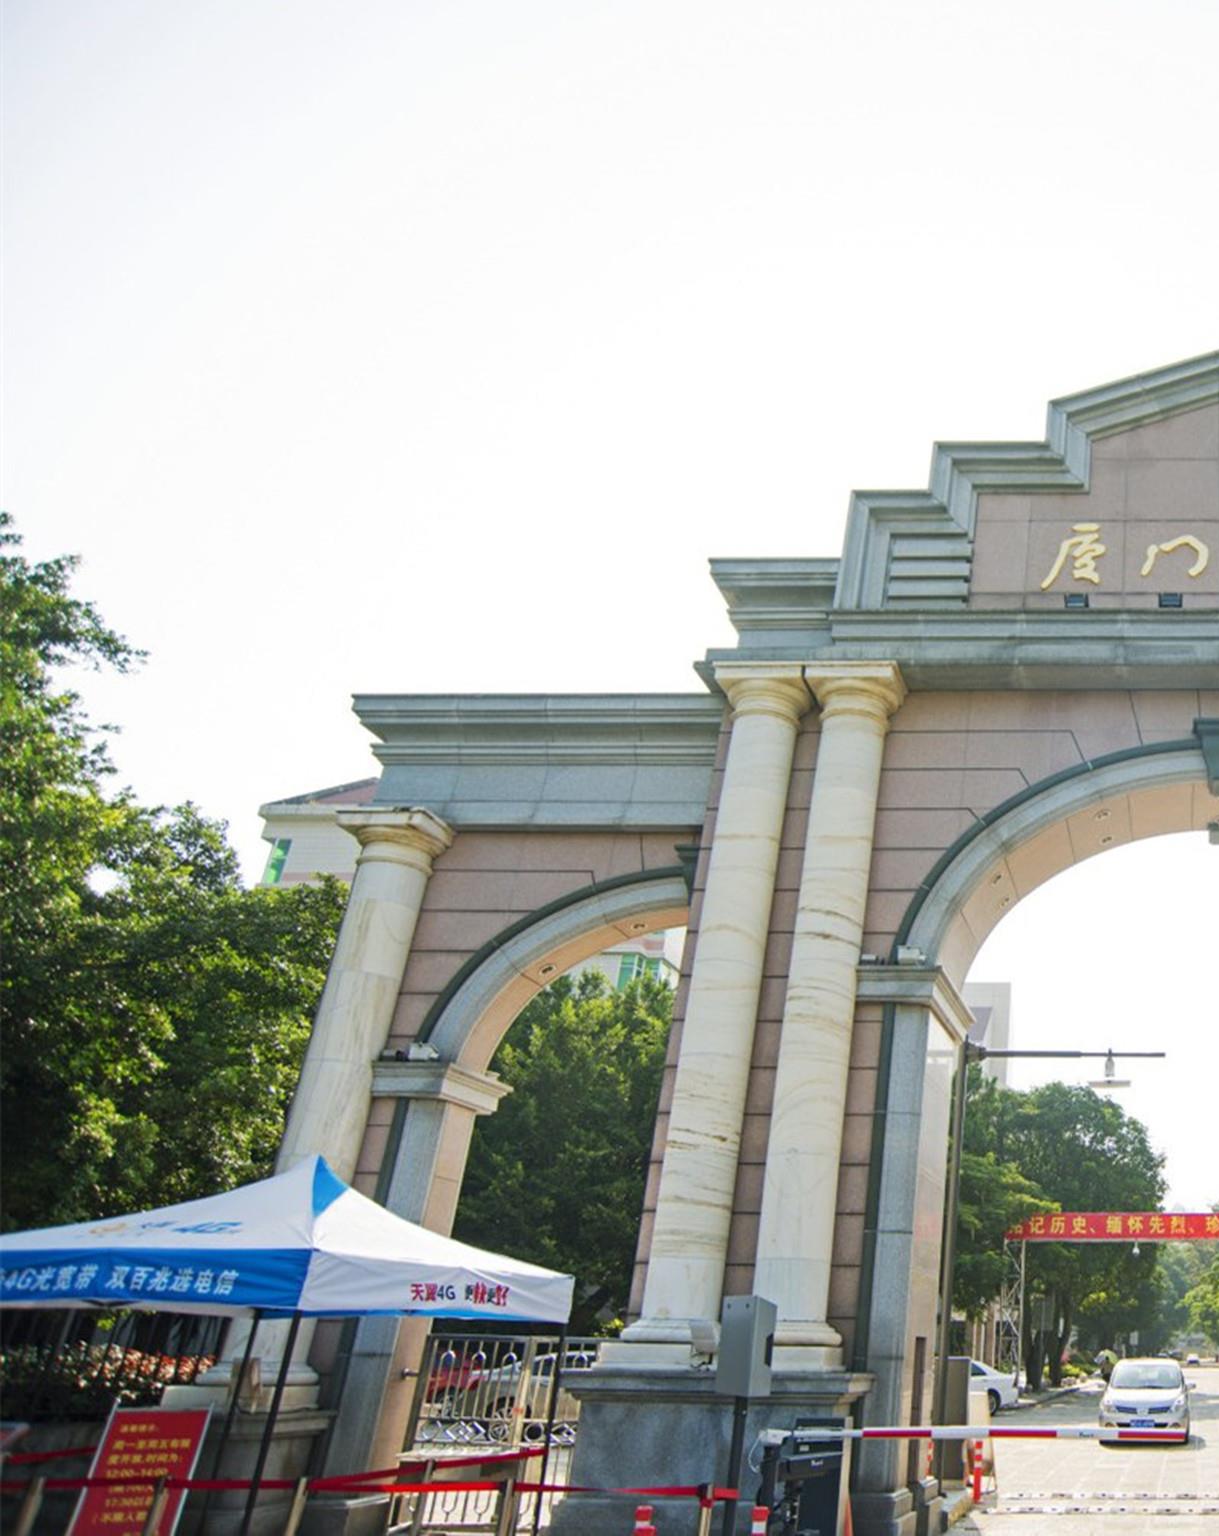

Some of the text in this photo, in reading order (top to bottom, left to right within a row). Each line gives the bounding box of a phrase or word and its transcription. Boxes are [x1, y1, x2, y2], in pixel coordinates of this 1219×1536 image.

[0, 1264, 239, 1295] 4G光宽带 双百兆选电信
[411, 1283, 456, 1302] 天翼4G
